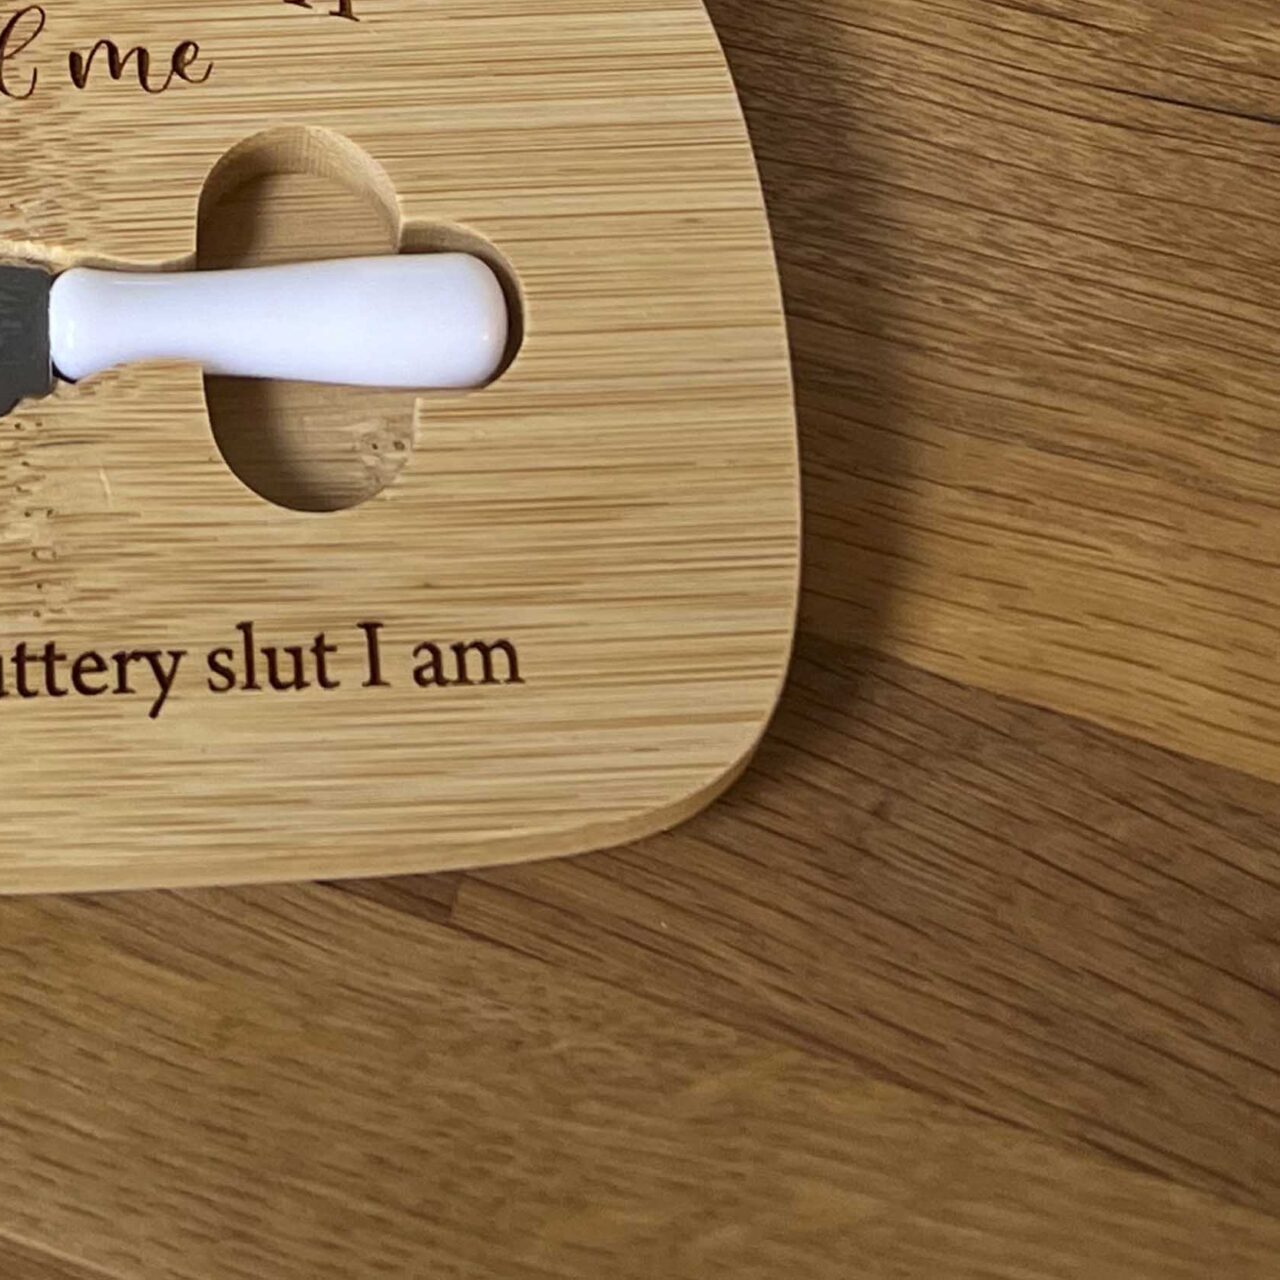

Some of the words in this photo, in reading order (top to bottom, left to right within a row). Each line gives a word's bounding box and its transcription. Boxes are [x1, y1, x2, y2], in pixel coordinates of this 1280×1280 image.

[67, 38, 215, 94] me
[206, 621, 341, 693] slut
[356, 621, 392, 688] I
[411, 636, 526, 687] am
